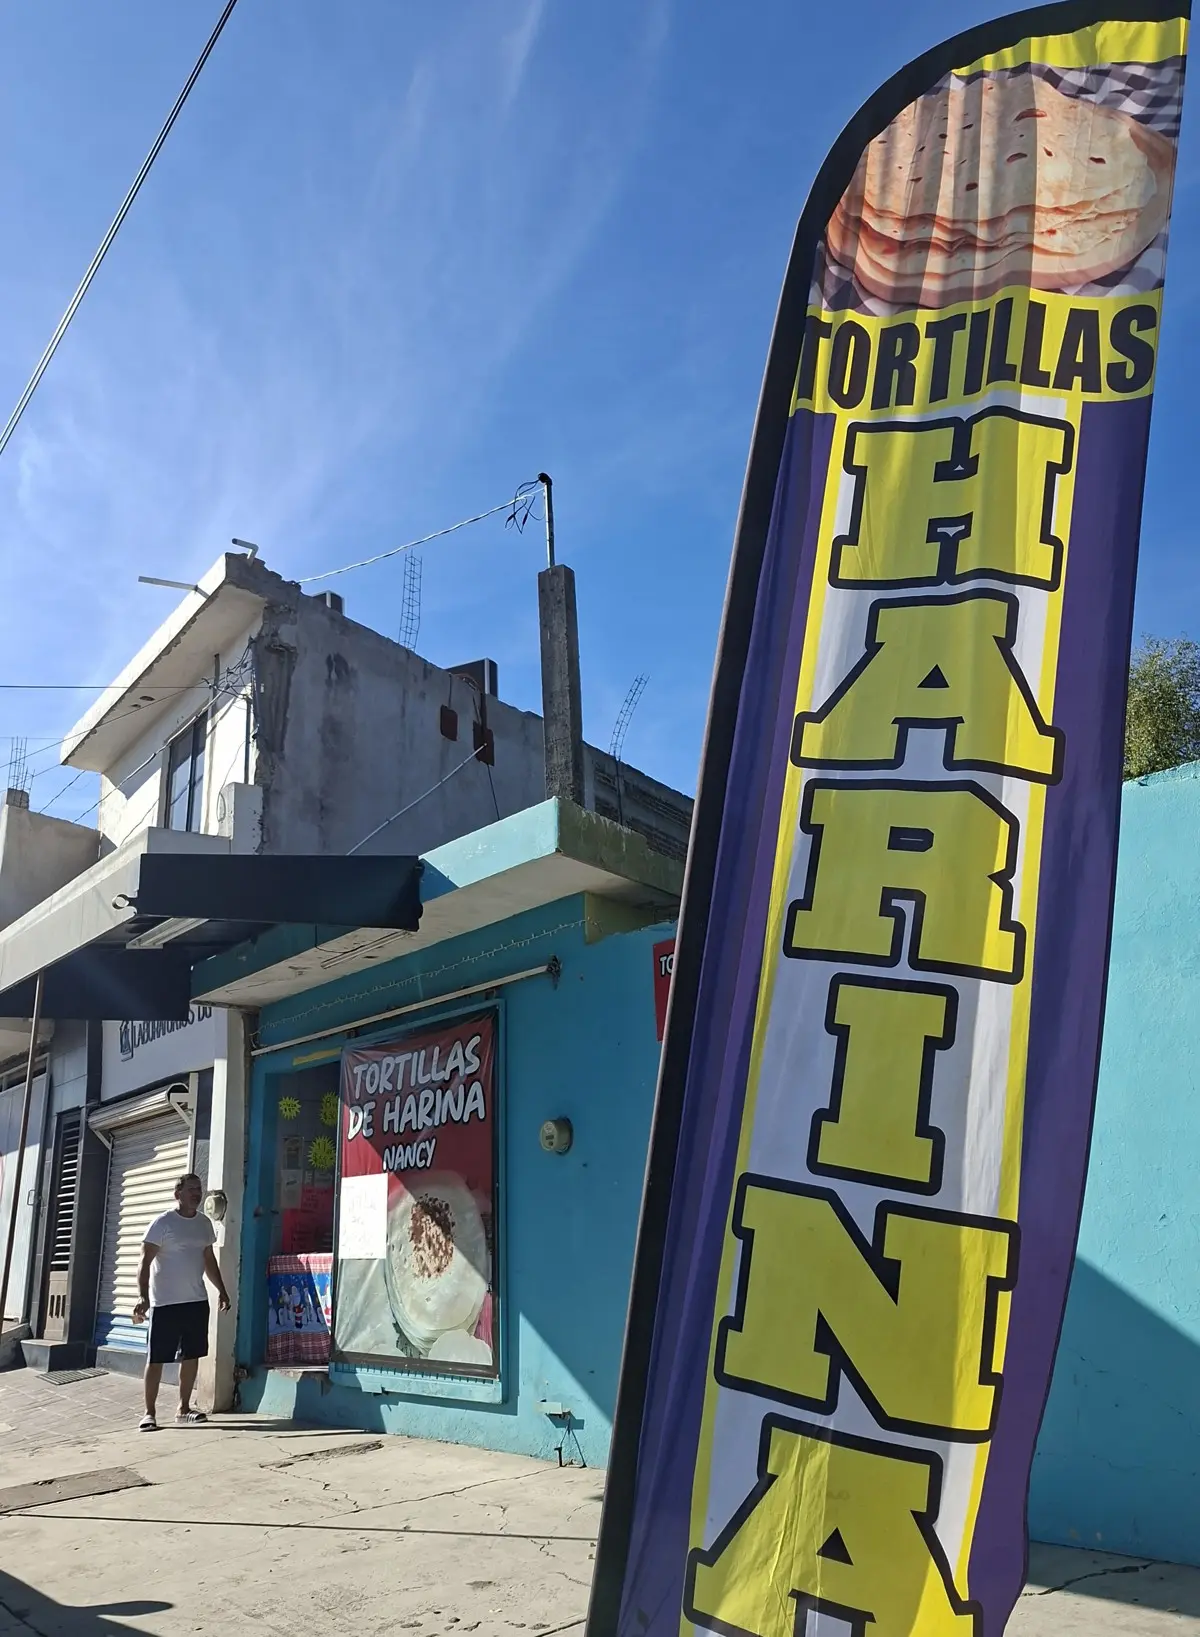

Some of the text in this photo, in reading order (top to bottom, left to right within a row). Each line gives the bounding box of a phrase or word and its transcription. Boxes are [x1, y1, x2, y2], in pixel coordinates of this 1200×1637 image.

[797, 296, 1157, 411] TORTILLAS
[683, 405, 1076, 1637] HARINA
[353, 1035, 481, 1099] TORTILLAS
[347, 1101, 376, 1140] DE
[382, 1081, 486, 1134] HARINA
[382, 1138, 437, 1171] NANCY
